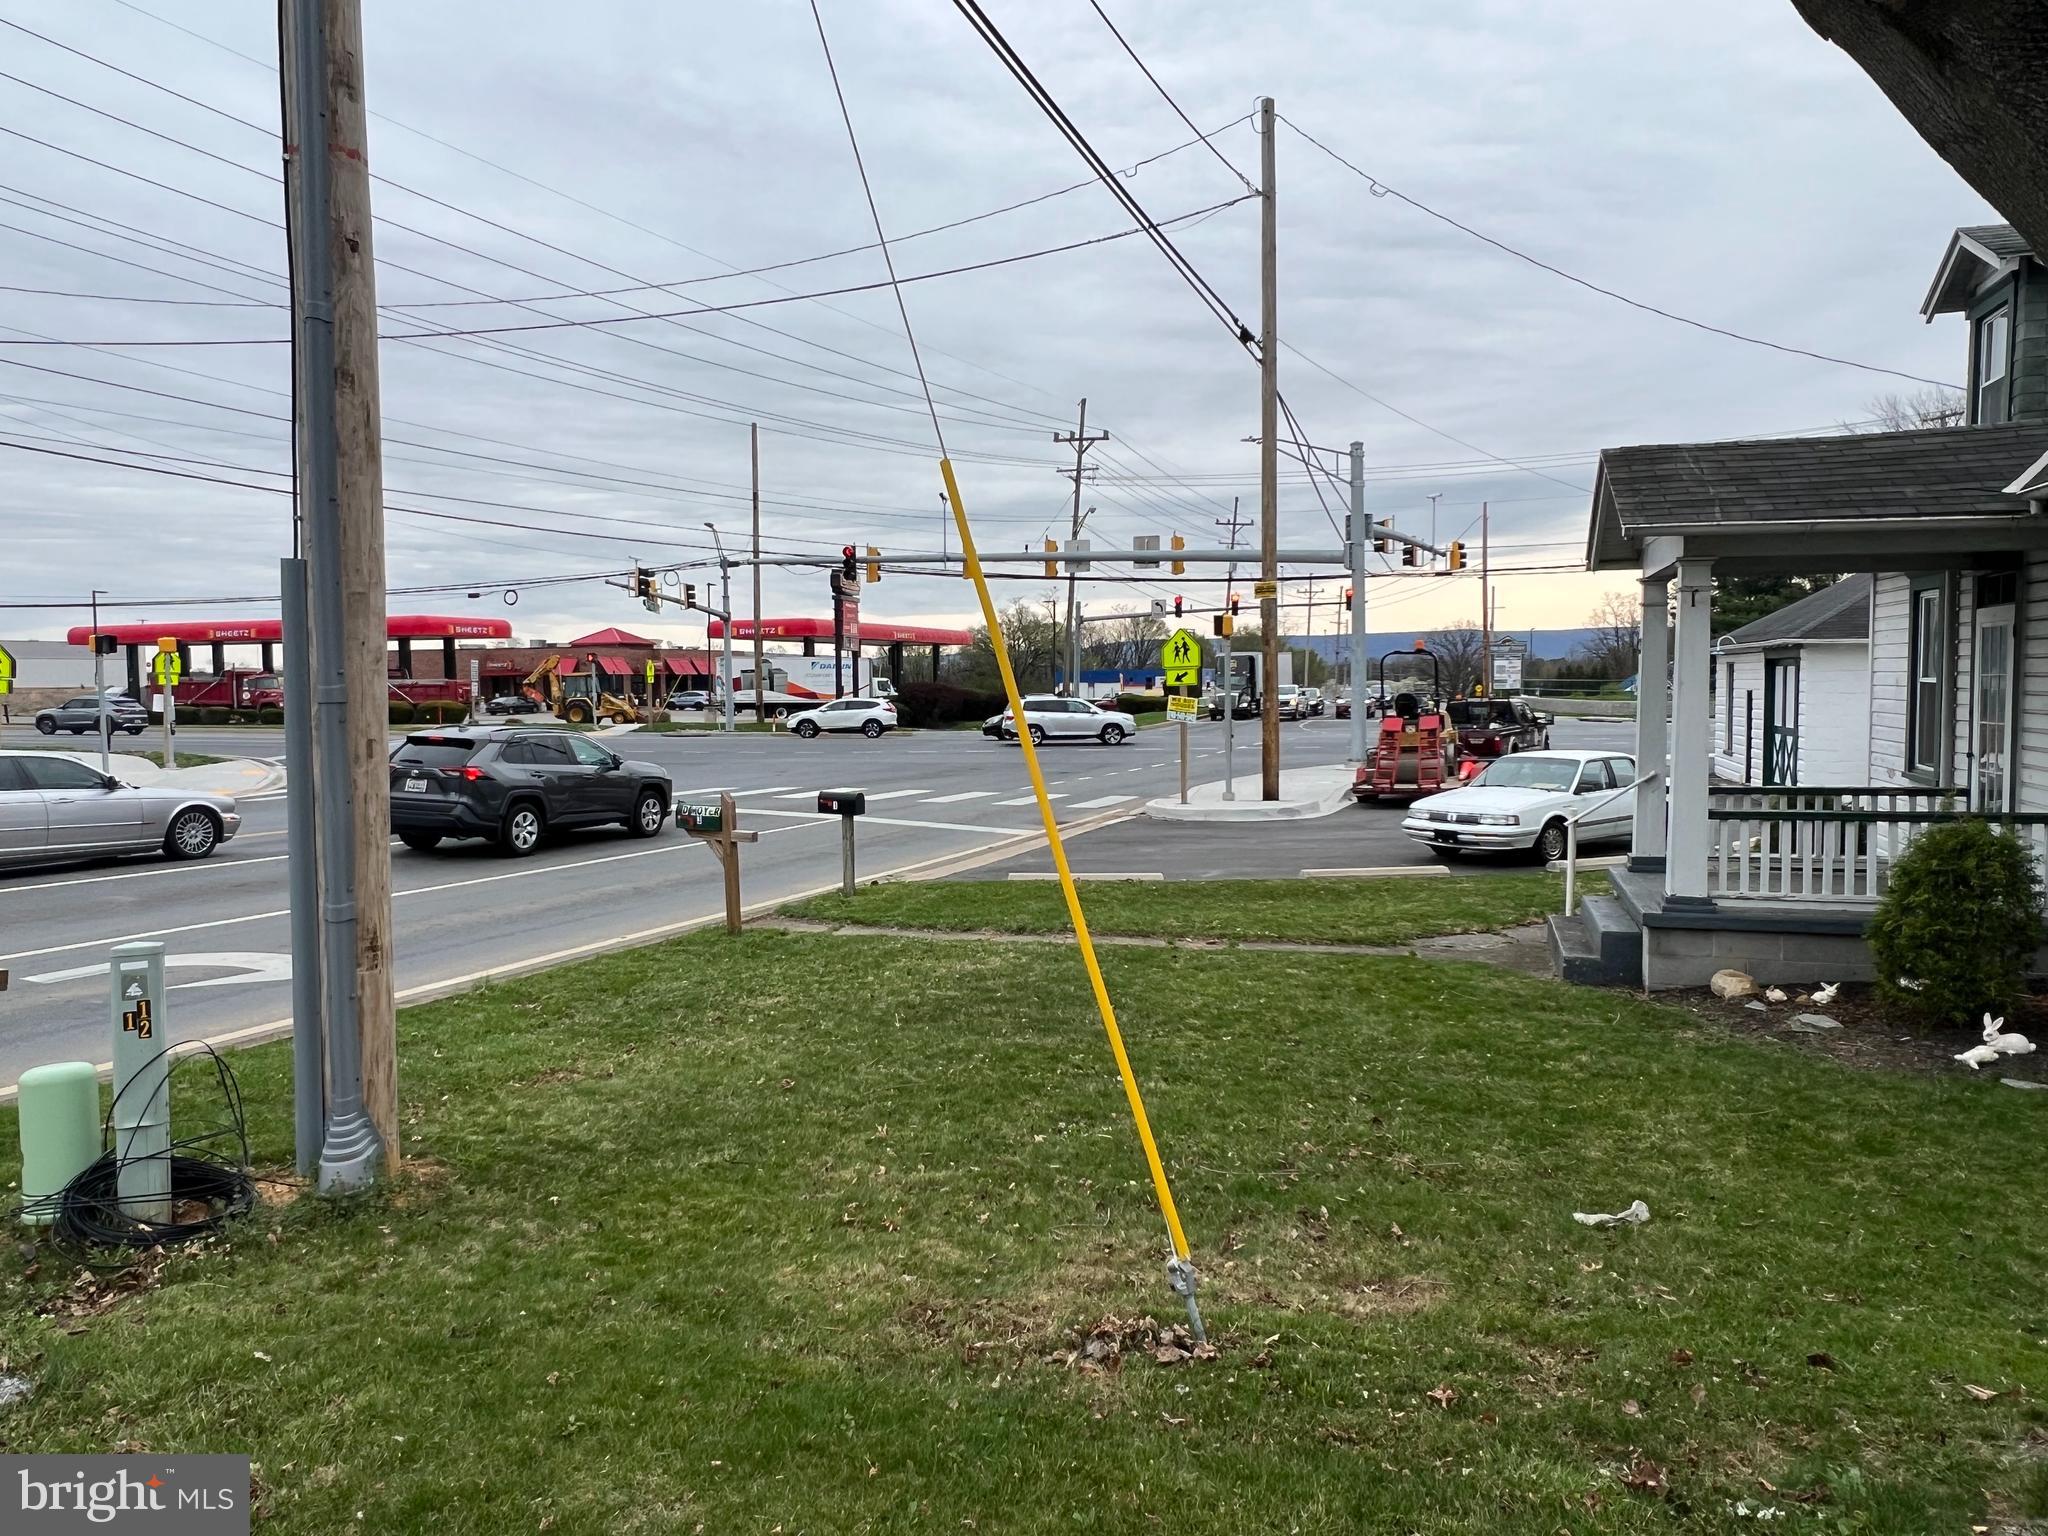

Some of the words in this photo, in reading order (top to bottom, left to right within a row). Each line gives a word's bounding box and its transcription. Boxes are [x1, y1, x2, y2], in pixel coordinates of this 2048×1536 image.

[139, 1001, 149, 1019] 1
[126, 1013, 135, 1030] 1
[140, 1020, 150, 1038] 2
